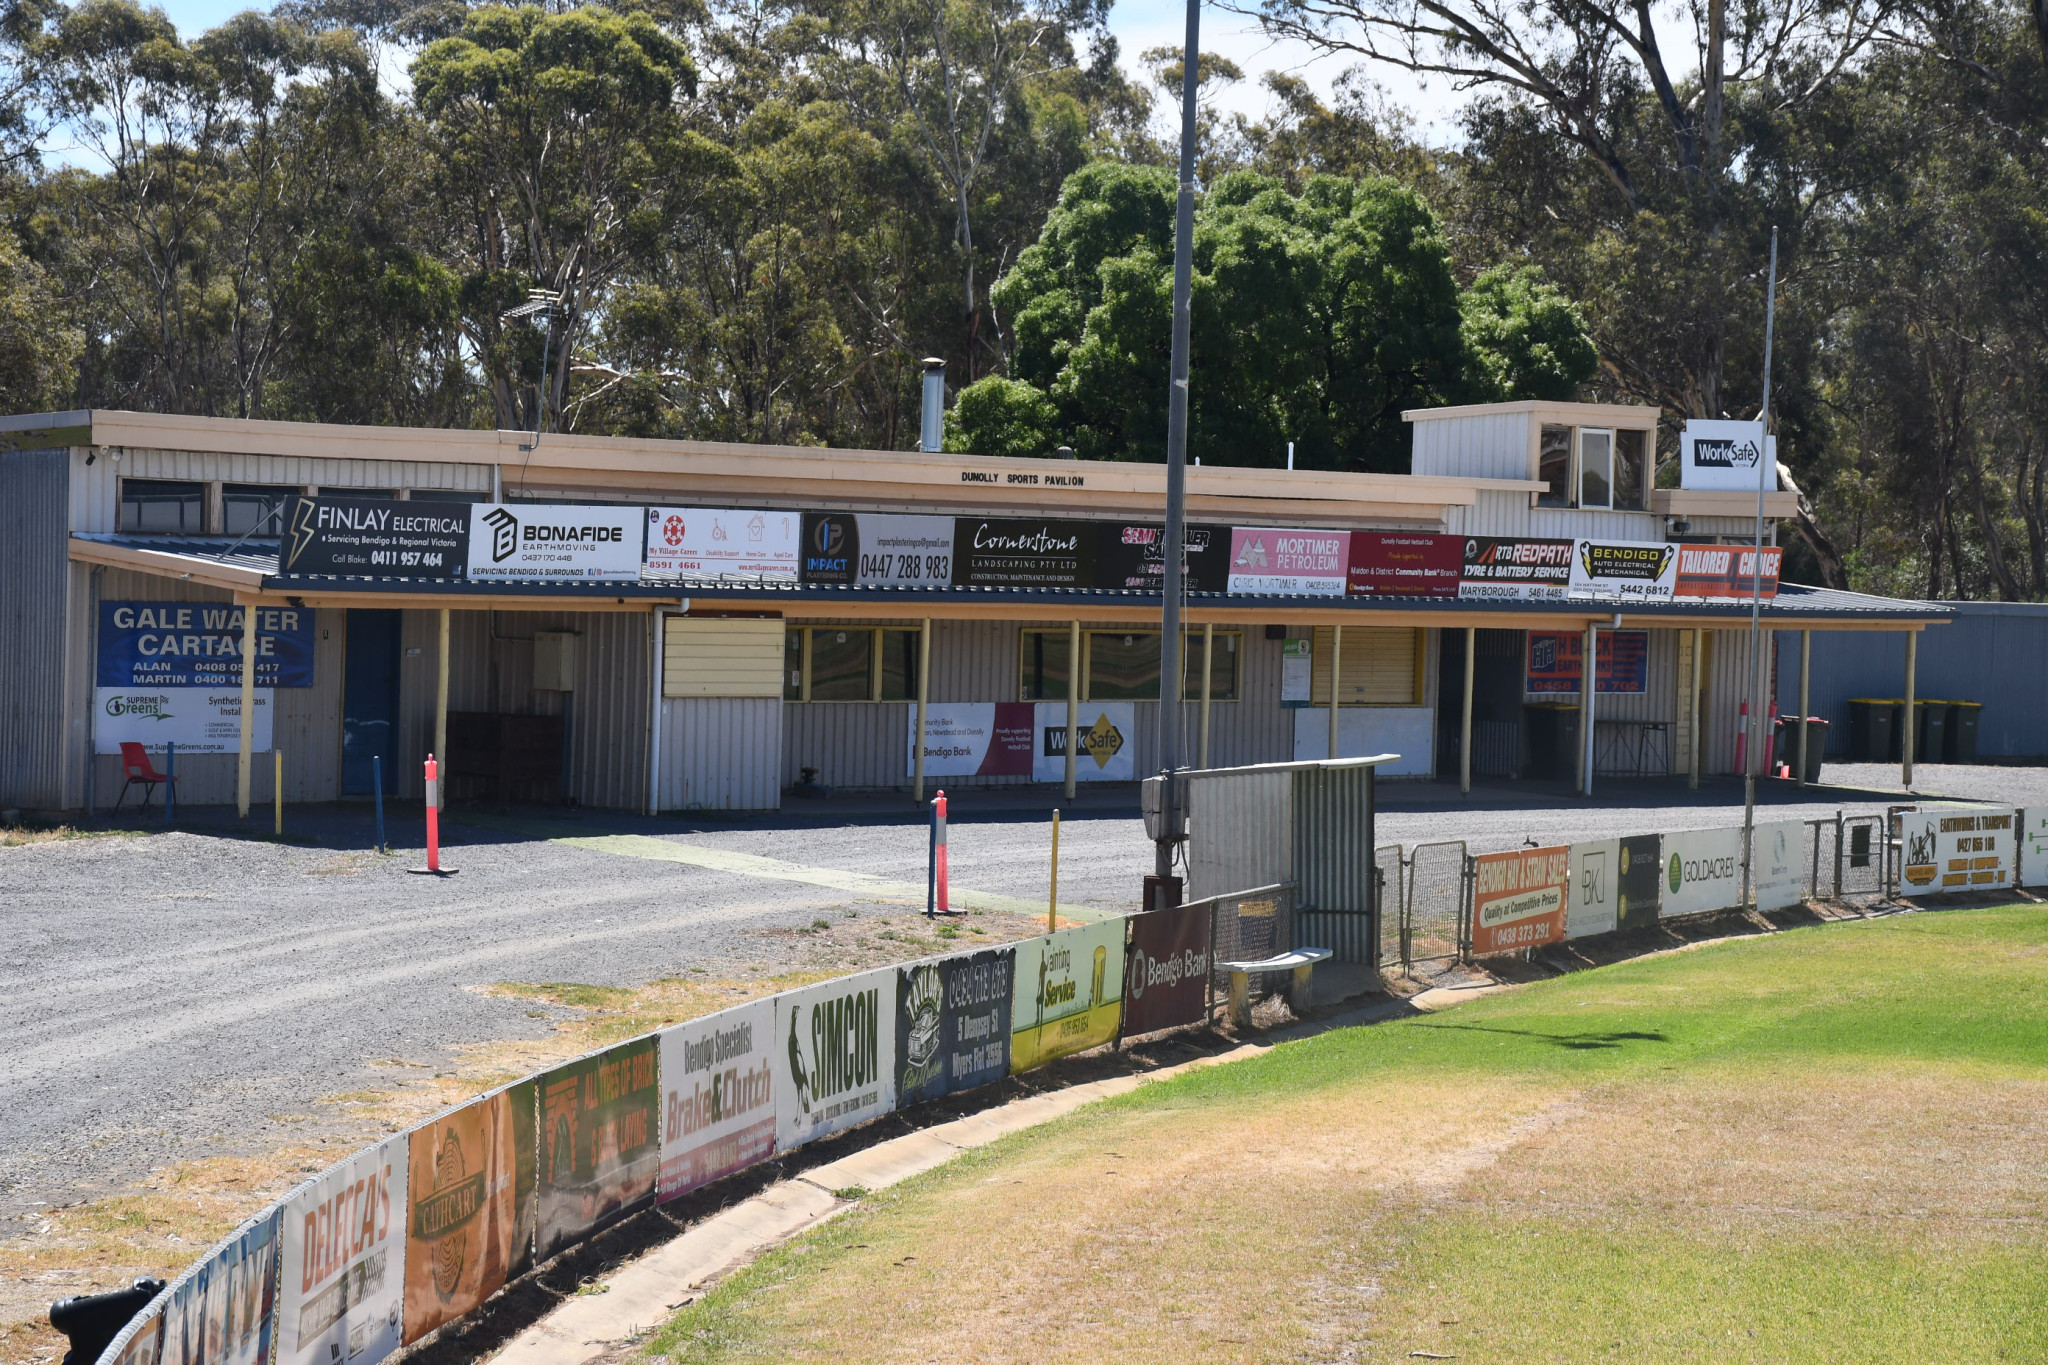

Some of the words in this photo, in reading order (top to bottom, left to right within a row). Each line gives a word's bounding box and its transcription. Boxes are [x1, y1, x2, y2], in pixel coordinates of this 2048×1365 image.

[1699, 443, 1754, 461] WorkSafe
[961, 471, 999, 483] DUNOLLY
[1007, 474, 1039, 484] SPORTS
[1045, 475, 1084, 486] PAVILION
[317, 506, 391, 531] FINLAY
[393, 516, 465, 534] ELECTRICAL
[327, 534, 360, 546] Servicing
[361, 535, 390, 547] Bendigo
[391, 536, 398, 545] &
[399, 537, 429, 547] Regional
[431, 537, 457, 547] Victoria
[523, 525, 623, 542] BONAFIDE
[973, 522, 1078, 553] Cornerstone
[1121, 527, 1157, 545] SEMI
[522, 543, 596, 551] EARTHMOVING
[659, 547, 679, 556] Village
[724, 550, 740, 558] Support
[1276, 538, 1340, 555] MORTIMER
[1495, 545, 1513, 560] RTB
[1511, 543, 1573, 565] REDPATH
[1593, 548, 1659, 560] BENDIGO
[332, 554, 346, 564] Call
[371, 550, 397, 566] 0411
[400, 551, 421, 566] 957
[422, 552, 442, 567] 464
[521, 554, 542, 562] 0437
[543, 554, 556, 562] 170
[649, 561, 673, 569] 8591
[678, 561, 701, 570] 4661
[807, 557, 848, 571] IMPACT
[861, 553, 893, 579] 0447
[897, 554, 921, 579] 288
[926, 555, 949, 579] 983
[971, 559, 1036, 569] LANDSCAPING
[1040, 560, 1056, 569] PTY
[1060, 561, 1077, 569] LTD
[1277, 554, 1339, 571] PETROLEUM
[1614, 561, 1656, 569] ELECTRICAL
[1680, 550, 1730, 574] TAILORED
[472, 567, 508, 576] SERVICING
[508, 568, 538, 576] BENDIGO
[544, 568, 584, 576] SURROUNDS
[1395, 568, 1423, 577] Community
[1463, 564, 1487, 577] TYRE
[1494, 565, 1533, 578] BATTERY
[1533, 566, 1569, 578] SERVICE
[1604, 568, 1649, 576] MECHANICAL
[1460, 585, 1520, 597] MARYBOROUGH
[1528, 588, 1544, 598] 5461
[1545, 588, 1563, 598] 4485
[1619, 584, 1643, 594] 5442
[1645, 585, 1669, 595] 6812
[113, 607, 193, 630] GALE
[133, 662, 171, 671] ALAN
[194, 663, 226, 672] 0408
[256, 664, 280, 672] 417
[132, 675, 187, 684] MARTIN
[194, 676, 226, 684] 0400
[257, 676, 279, 684] 711
[1533, 681, 1572, 690] 0458
[126, 696, 159, 704] SUPREME
[913, 718, 941, 727] Cmunity
[1050, 730, 1117, 749] WkSafe
[923, 746, 952, 759] Bendigo
[953, 746, 972, 756] Bank
[1478, 860, 1506, 894] BENDIGO
[1506, 858, 1521, 891] HAY
[1526, 855, 1548, 888] STRAW
[1547, 853, 1567, 885] SALES
[1683, 857, 1734, 883] GOLDACRES
[1484, 902, 1503, 921] Quality
[1510, 896, 1540, 914] Competitive
[1541, 893, 1558, 907] Prices
[1518, 924, 1533, 942] 373
[1535, 922, 1550, 940] 291
[1148, 952, 1183, 988] Bendigo
[1185, 946, 1208, 978] Bank
[1044, 975, 1076, 1008] Service
[957, 1016, 963, 1041] 5
[964, 1014, 991, 1041] Dempsey
[991, 1008, 999, 1034] St
[684, 1034, 714, 1076] Bendigo
[714, 1021, 753, 1066] Specialist
[811, 988, 878, 1103] SIMCON
[952, 1052, 973, 1081] Myers
[973, 1046, 985, 1072] Flat
[986, 1041, 1003, 1069] 3556
[584, 1070, 599, 1111] ALL
[599, 1060, 620, 1105] TYPES
[621, 1058, 630, 1096] OF
[632, 1050, 654, 1092] BRICK
[620, 1107, 648, 1153] LAYING
[423, 1185, 477, 1235] CATHCART
[301, 1163, 392, 1296] DELECCA'S
